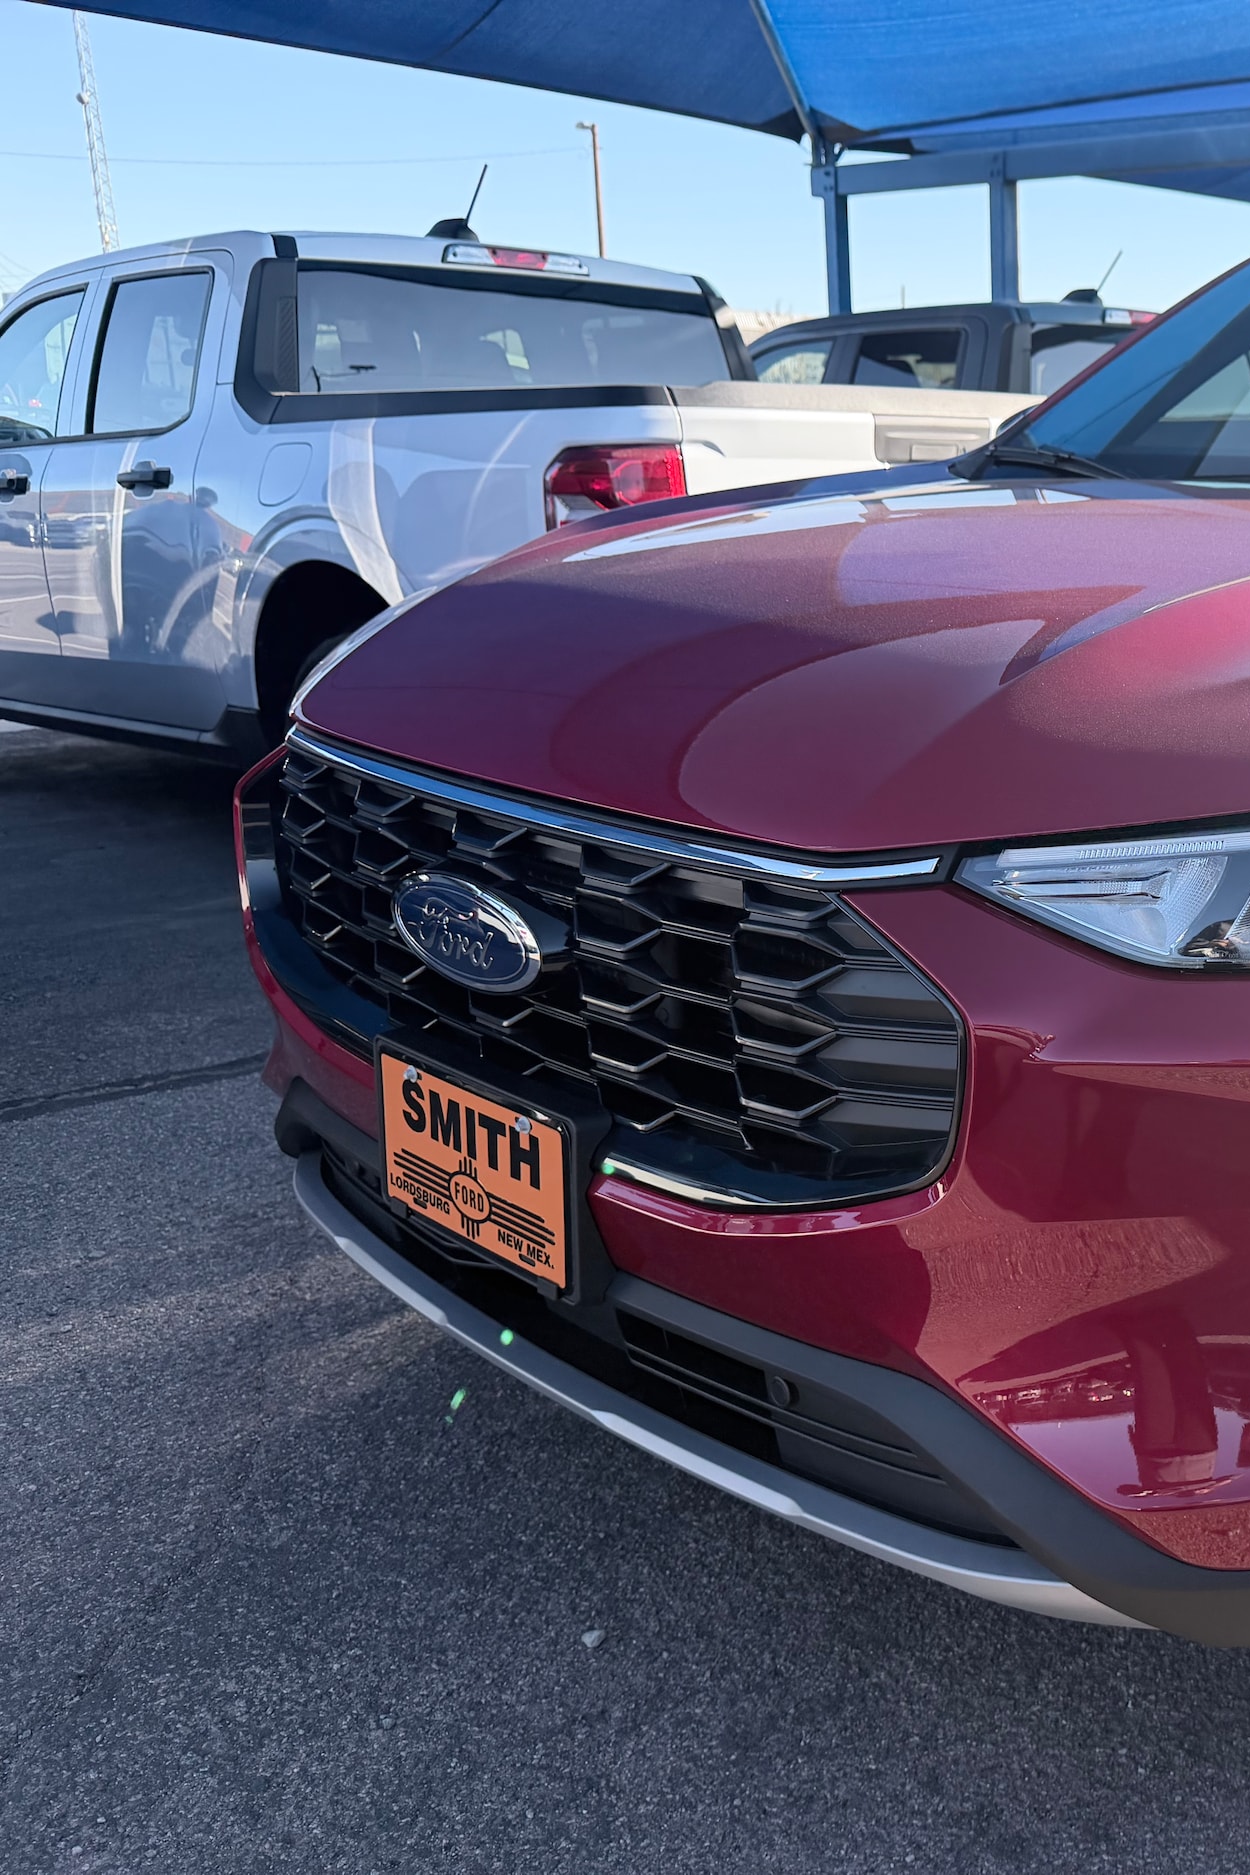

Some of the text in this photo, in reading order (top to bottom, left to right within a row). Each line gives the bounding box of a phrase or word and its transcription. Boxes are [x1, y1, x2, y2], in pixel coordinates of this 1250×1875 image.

[407, 897, 494, 970] Ford
[402, 1077, 541, 1191] SMITH
[390, 1172, 450, 1215] LORDSBURG
[454, 1181, 484, 1213] FORD
[497, 1229, 555, 1270] NEW MEX.
